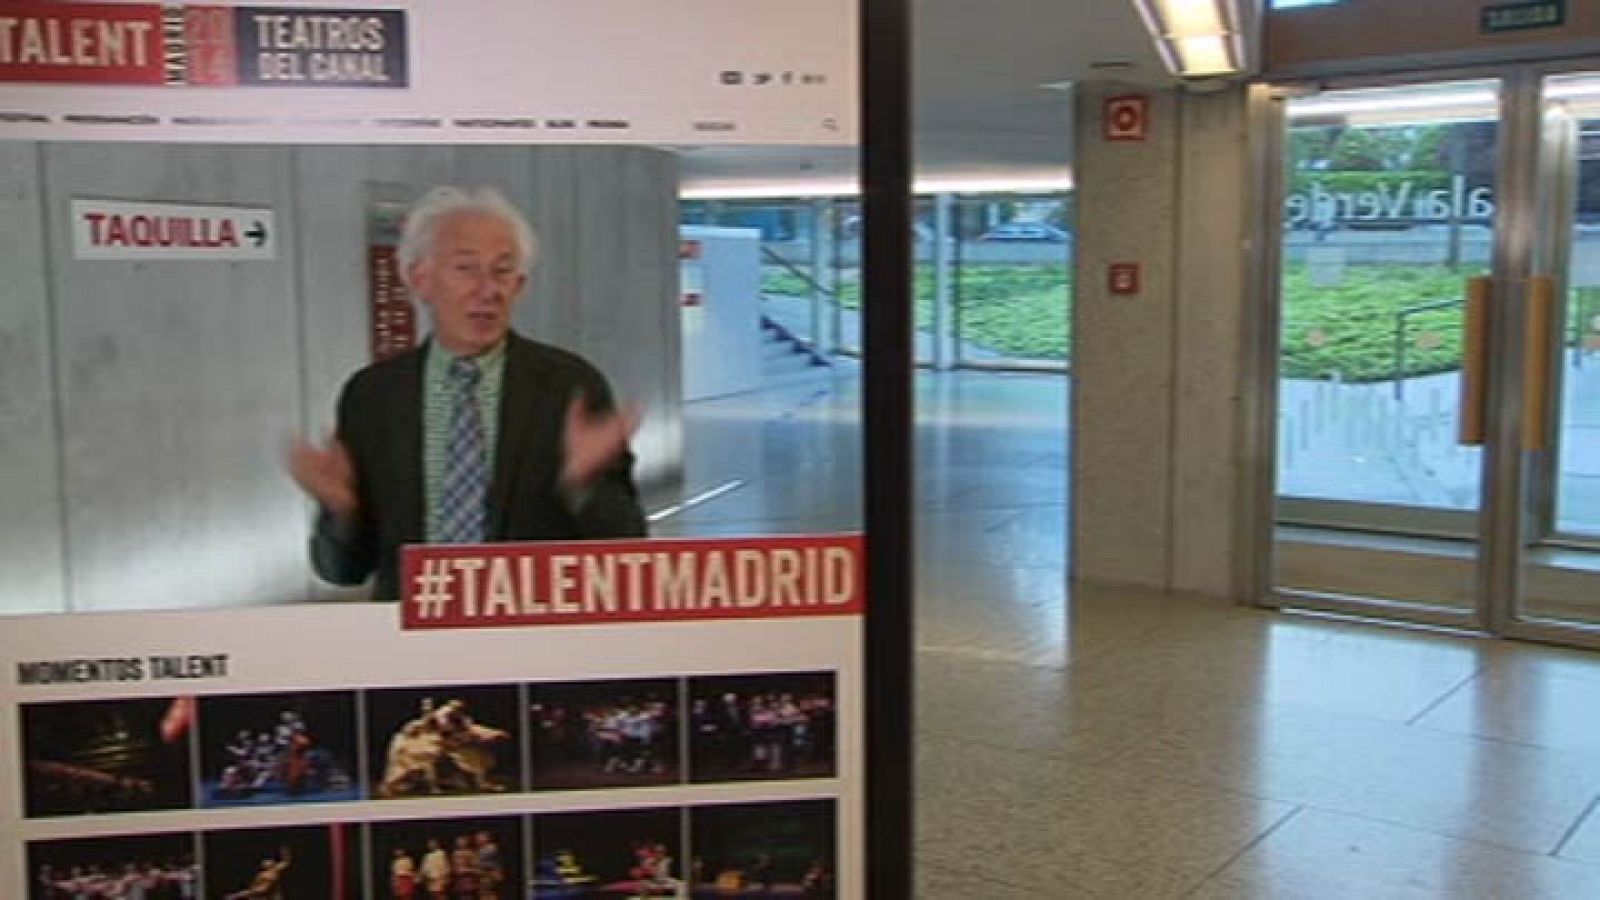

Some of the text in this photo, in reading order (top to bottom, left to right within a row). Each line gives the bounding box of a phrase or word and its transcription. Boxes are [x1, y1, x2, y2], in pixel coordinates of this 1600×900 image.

[0, 19, 153, 67] TALENT
[253, 15, 386, 50] TEATROS
[258, 53, 304, 81] DEL
[84, 213, 240, 248] TAQUILLA
[413, 547, 855, 619] #TALENTMADRID
[148, 655, 229, 679] TALENT
